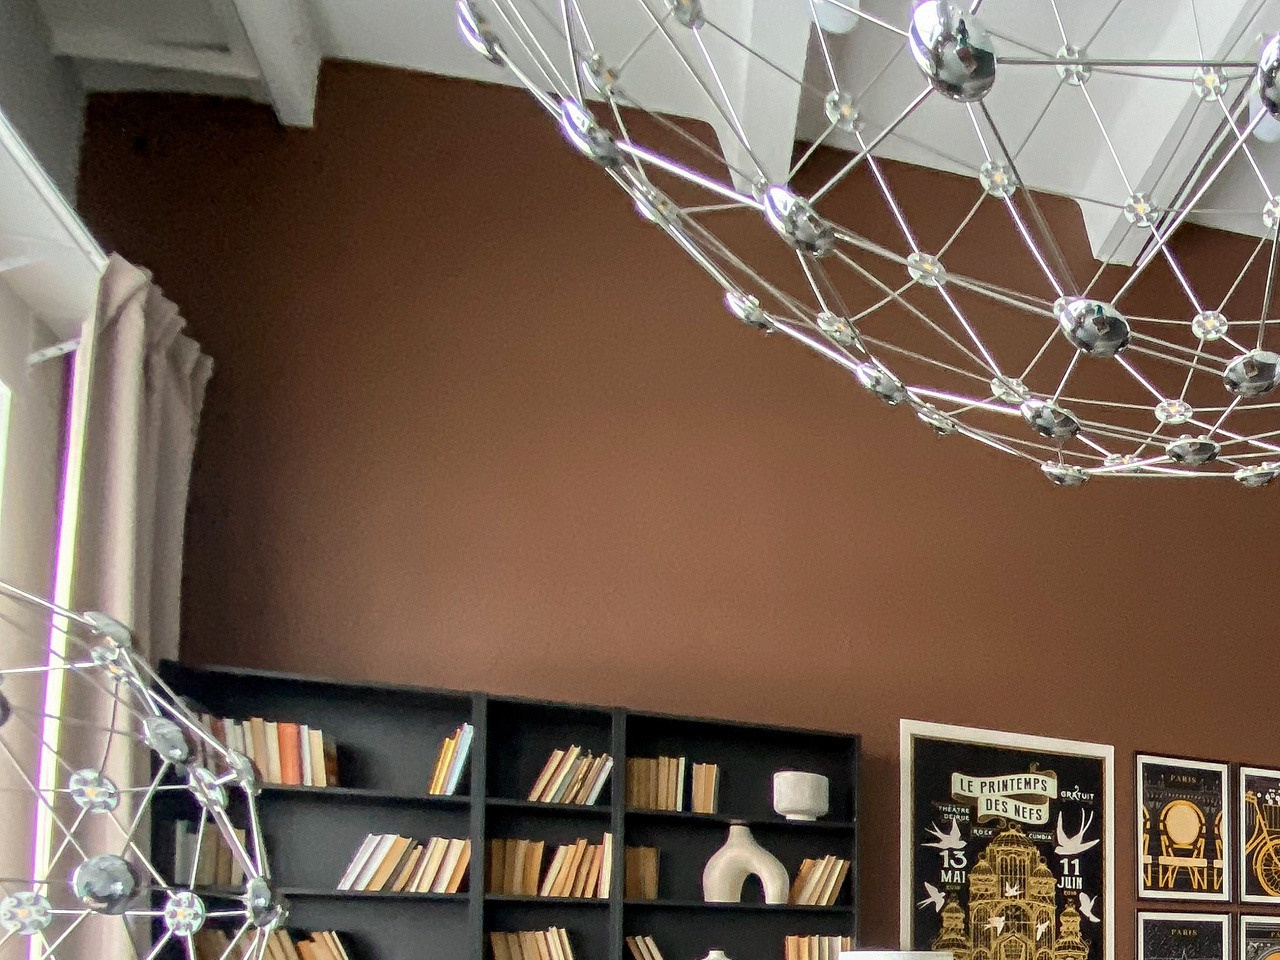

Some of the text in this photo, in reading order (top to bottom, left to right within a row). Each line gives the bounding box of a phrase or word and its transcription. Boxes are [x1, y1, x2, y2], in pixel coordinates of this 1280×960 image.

[960, 777, 1048, 794] LE PRINTEMPS
[1170, 774, 1197, 784] PARIS
[1060, 785, 1095, 801] GRATUIT
[985, 798, 1042, 821] DES NEFS
[956, 814, 970, 822] RUE
[939, 850, 967, 869] 13
[1059, 858, 1080, 876] 11
[940, 870, 966, 884] MAI
[1057, 876, 1083, 889] JUIN
[1171, 929, 1198, 937] PARIS
